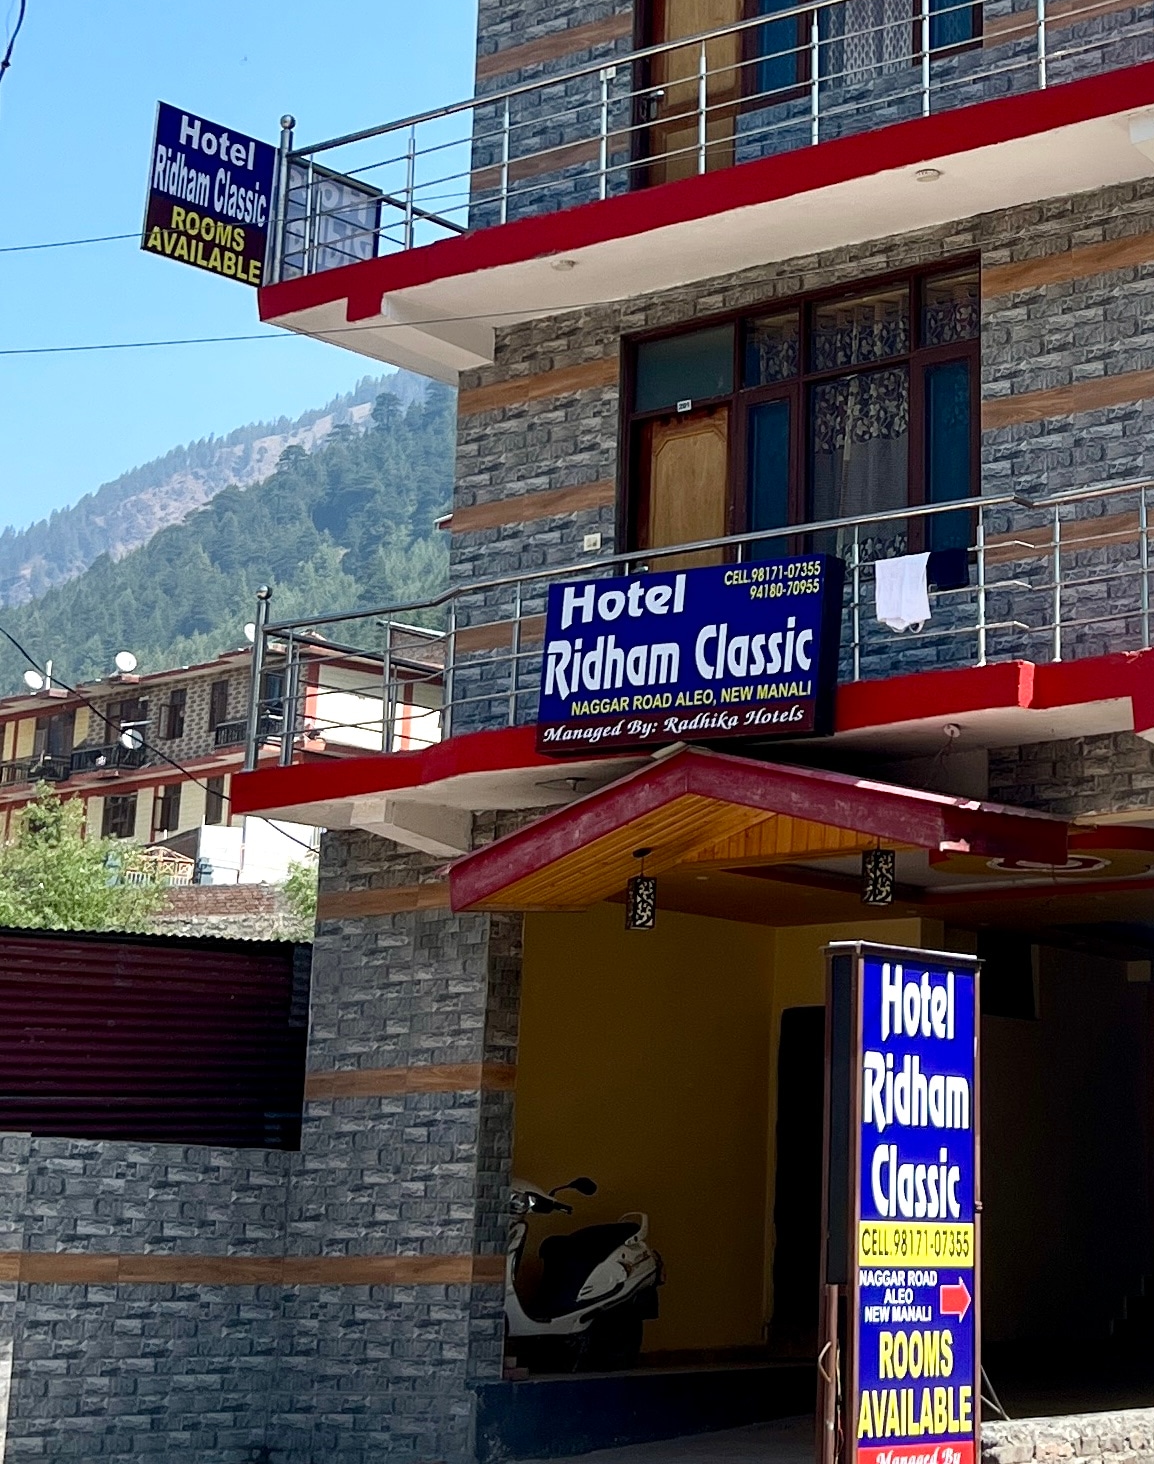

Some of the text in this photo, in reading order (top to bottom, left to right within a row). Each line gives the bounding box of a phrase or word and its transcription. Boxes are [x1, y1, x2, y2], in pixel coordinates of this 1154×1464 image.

[179, 114, 256, 170] Hotel
[153, 144, 211, 208] Ridham
[214, 167, 267, 227] Classic
[147, 226, 262, 284] AVAILABLE
[171, 205, 246, 251] ROOMS
[561, 573, 687, 630] Hotel
[750, 578, 820, 600] 94180-70955
[544, 616, 813, 701] Ridham Classic
[542, 704, 805, 743] Managed By: Radhika Hotels
[571, 680, 812, 716] NAGGAR ROAD ALEO, NEW MANALI
[881, 962, 954, 1042] Hotel
[863, 1050, 970, 1133] Ridham
[871, 1143, 961, 1219] Classic
[859, 1270, 938, 1286] NAGGAR ROAD
[884, 1288, 914, 1305] ALEO
[864, 1306, 932, 1323] NEW MANALI
[878, 1329, 954, 1379] ROOMS
[857, 1385, 973, 1439] AVAILABLE
